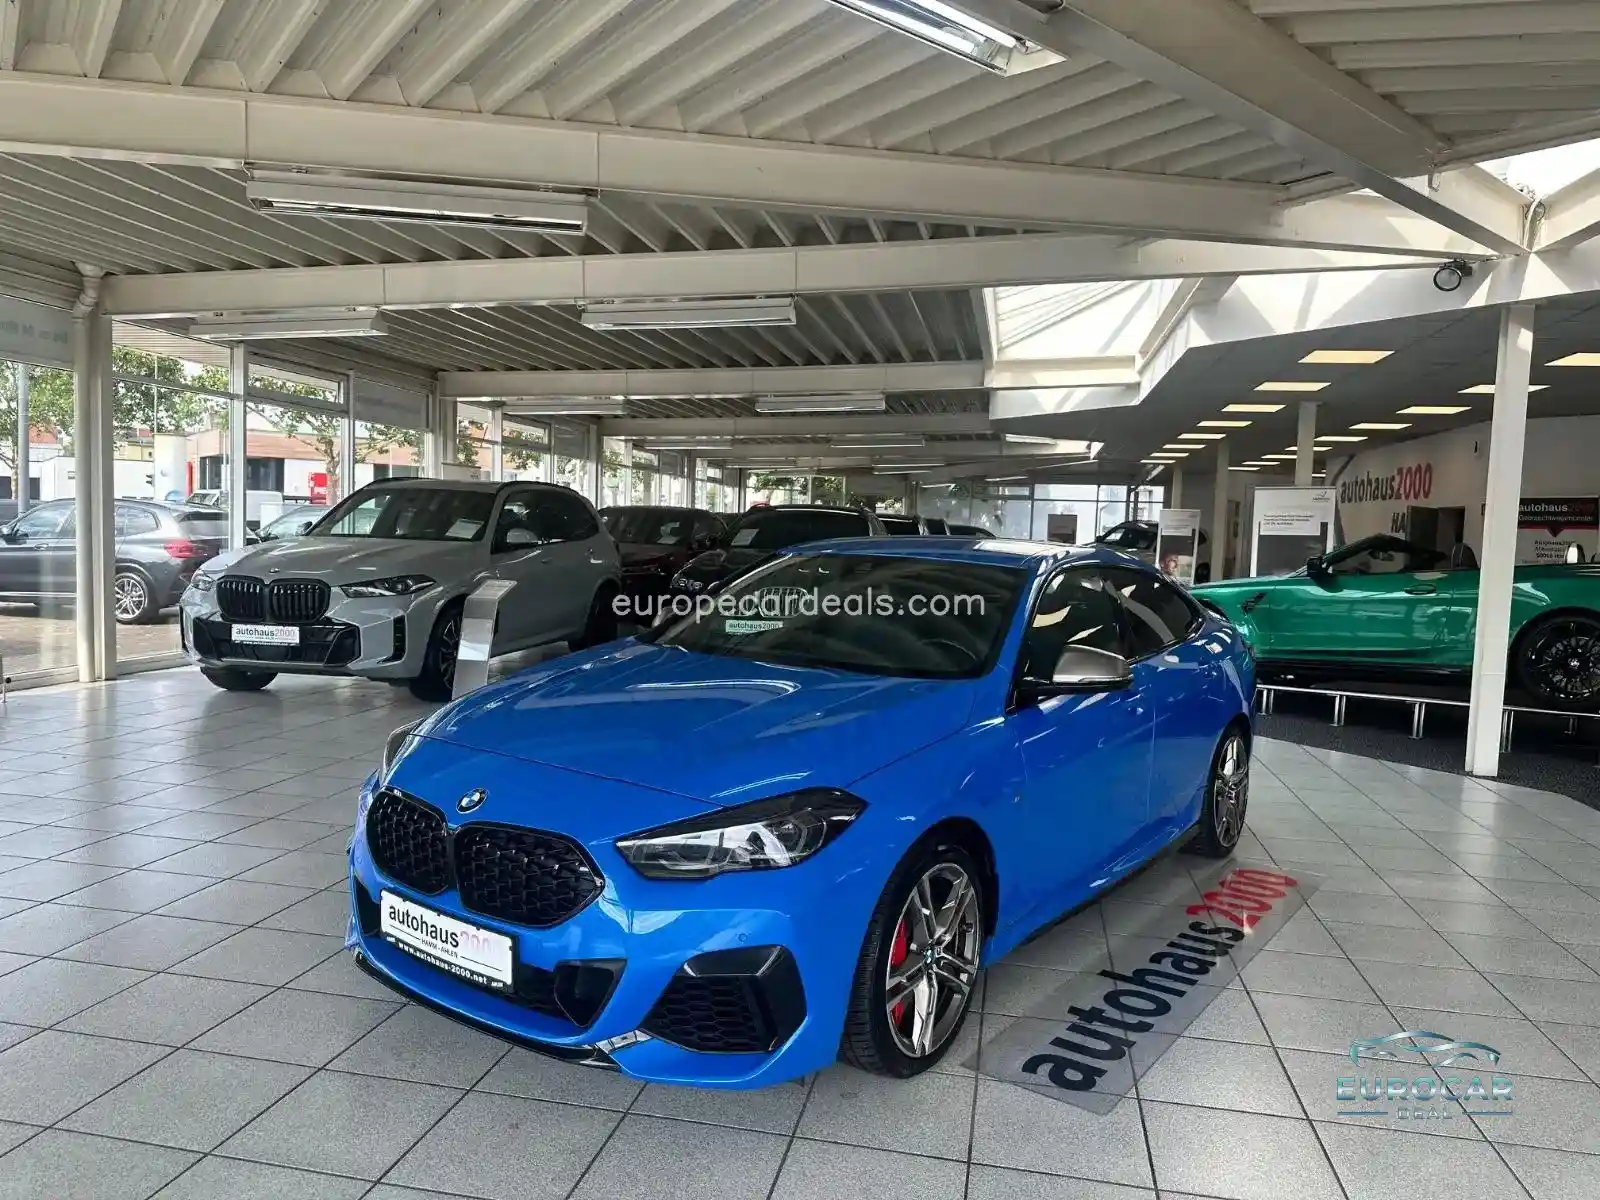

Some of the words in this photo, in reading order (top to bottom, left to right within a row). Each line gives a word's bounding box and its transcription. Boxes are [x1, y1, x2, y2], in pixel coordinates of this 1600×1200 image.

[1340, 462, 1433, 504] autohaus2000
[1391, 512, 1407, 534] HA
[235, 627, 296, 637] autohaus2000
[1021, 867, 1300, 1092] autohaus2000
